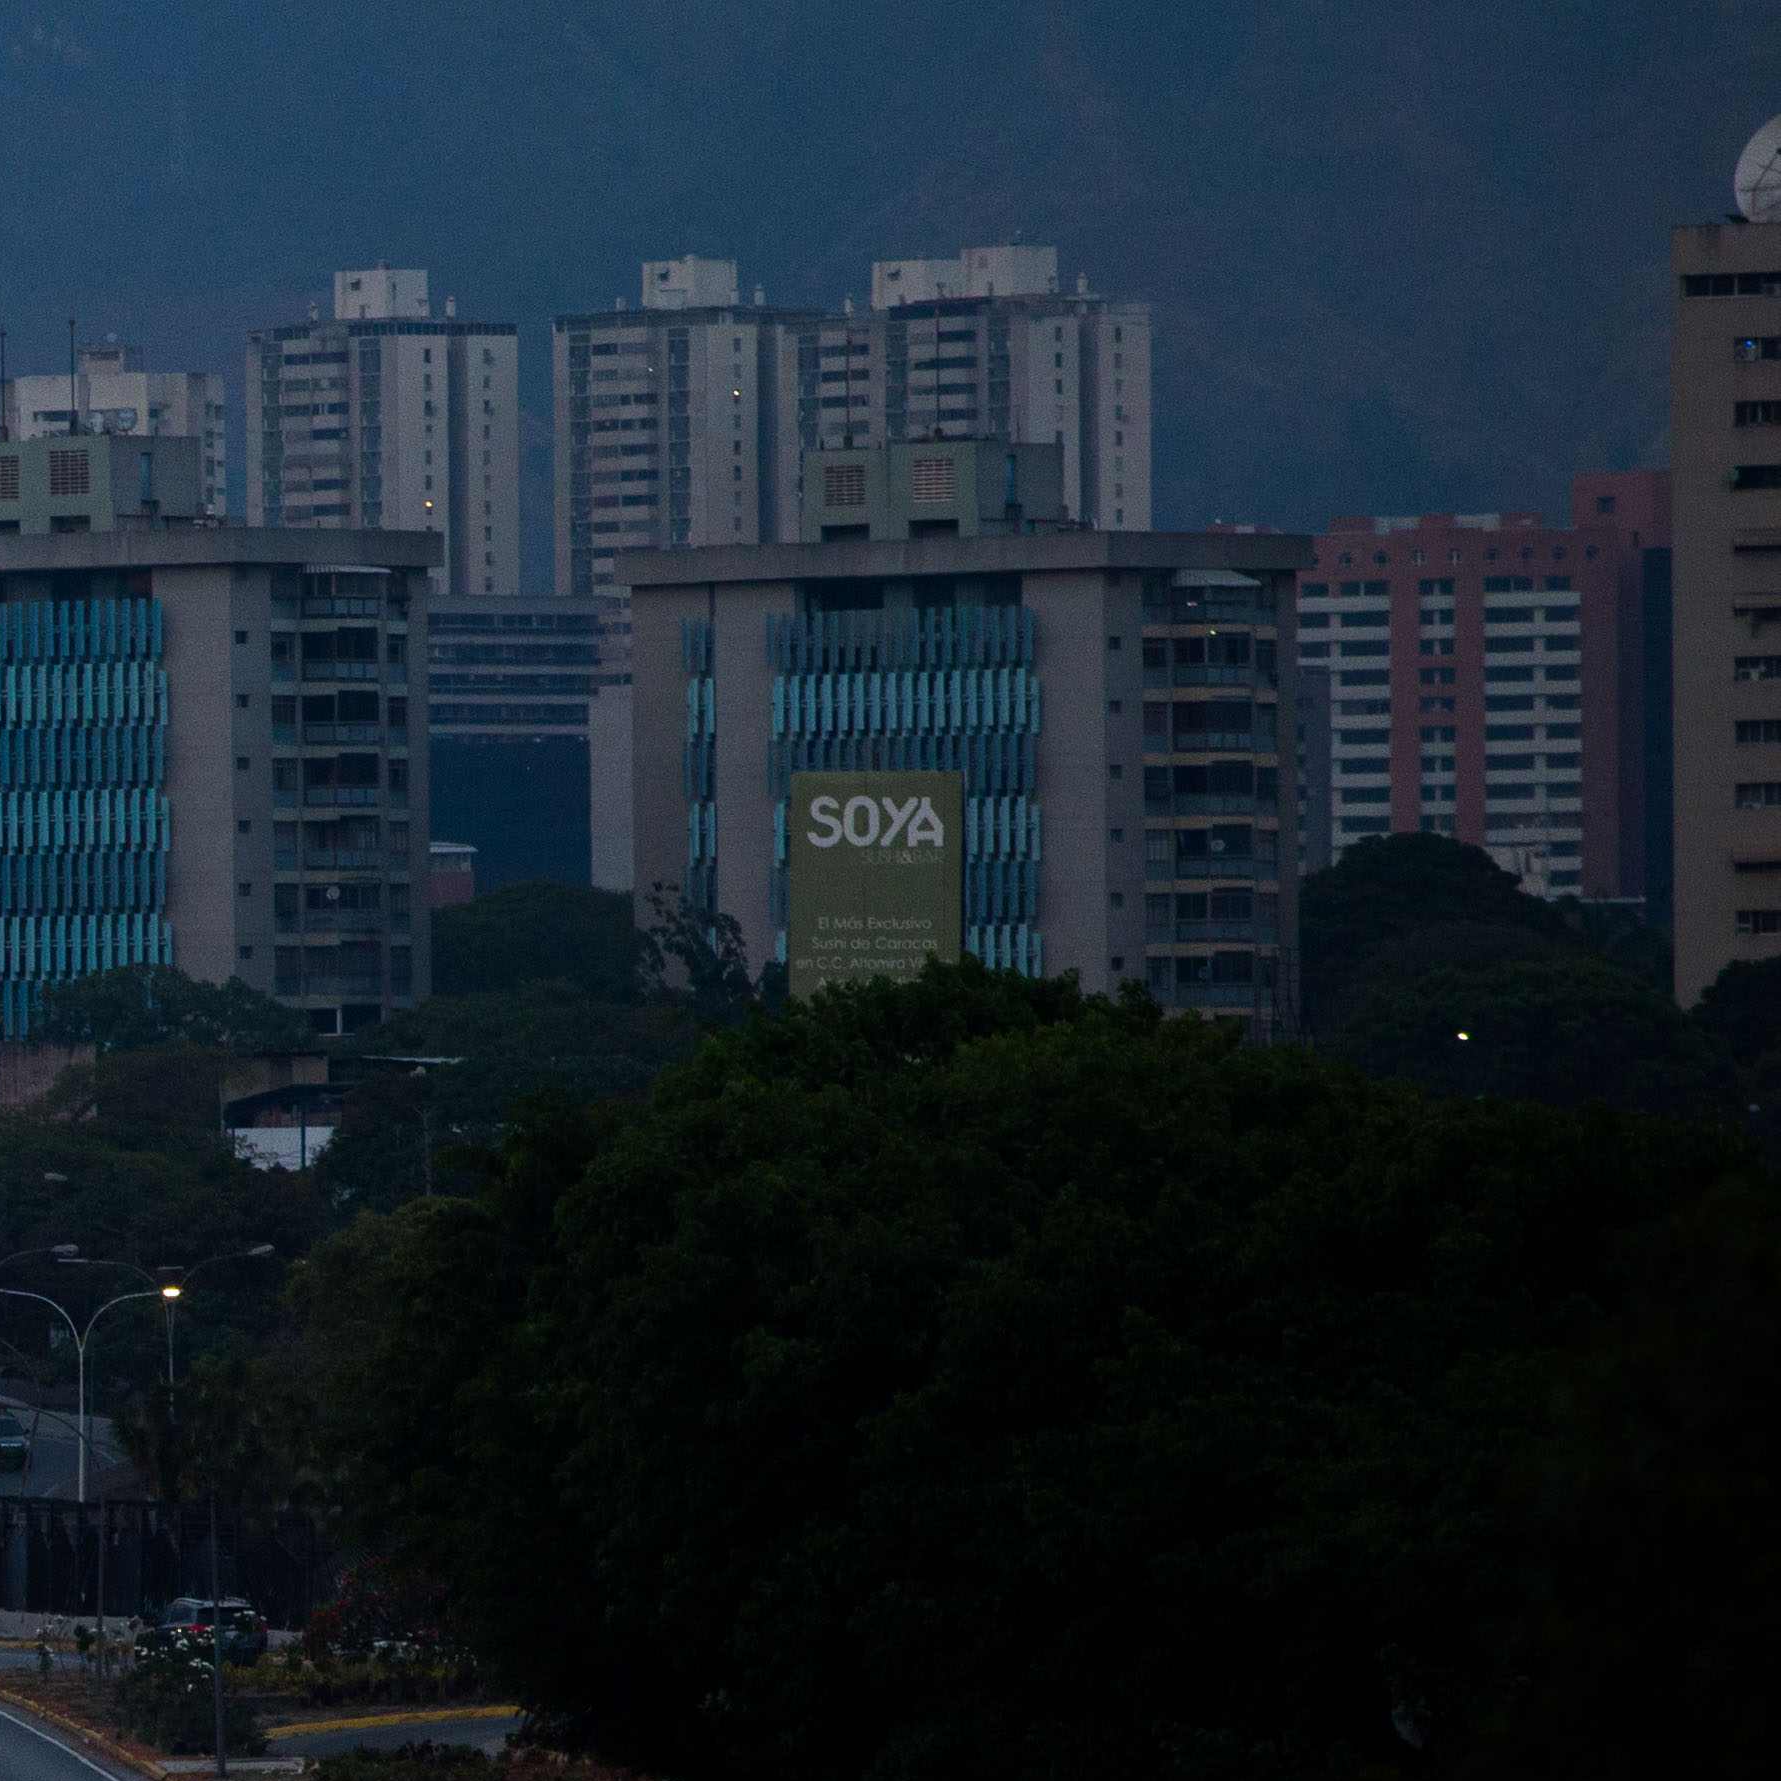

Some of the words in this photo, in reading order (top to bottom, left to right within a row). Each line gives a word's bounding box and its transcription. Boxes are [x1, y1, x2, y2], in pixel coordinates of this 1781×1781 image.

[806, 795, 944, 848] SOYA
[818, 916, 830, 930] El
[834, 916, 863, 930] Más
[868, 916, 932, 930] Exclusivo
[811, 936, 846, 950] Sushi
[850, 936, 870, 950] de
[875, 937, 938, 950] Caracas
